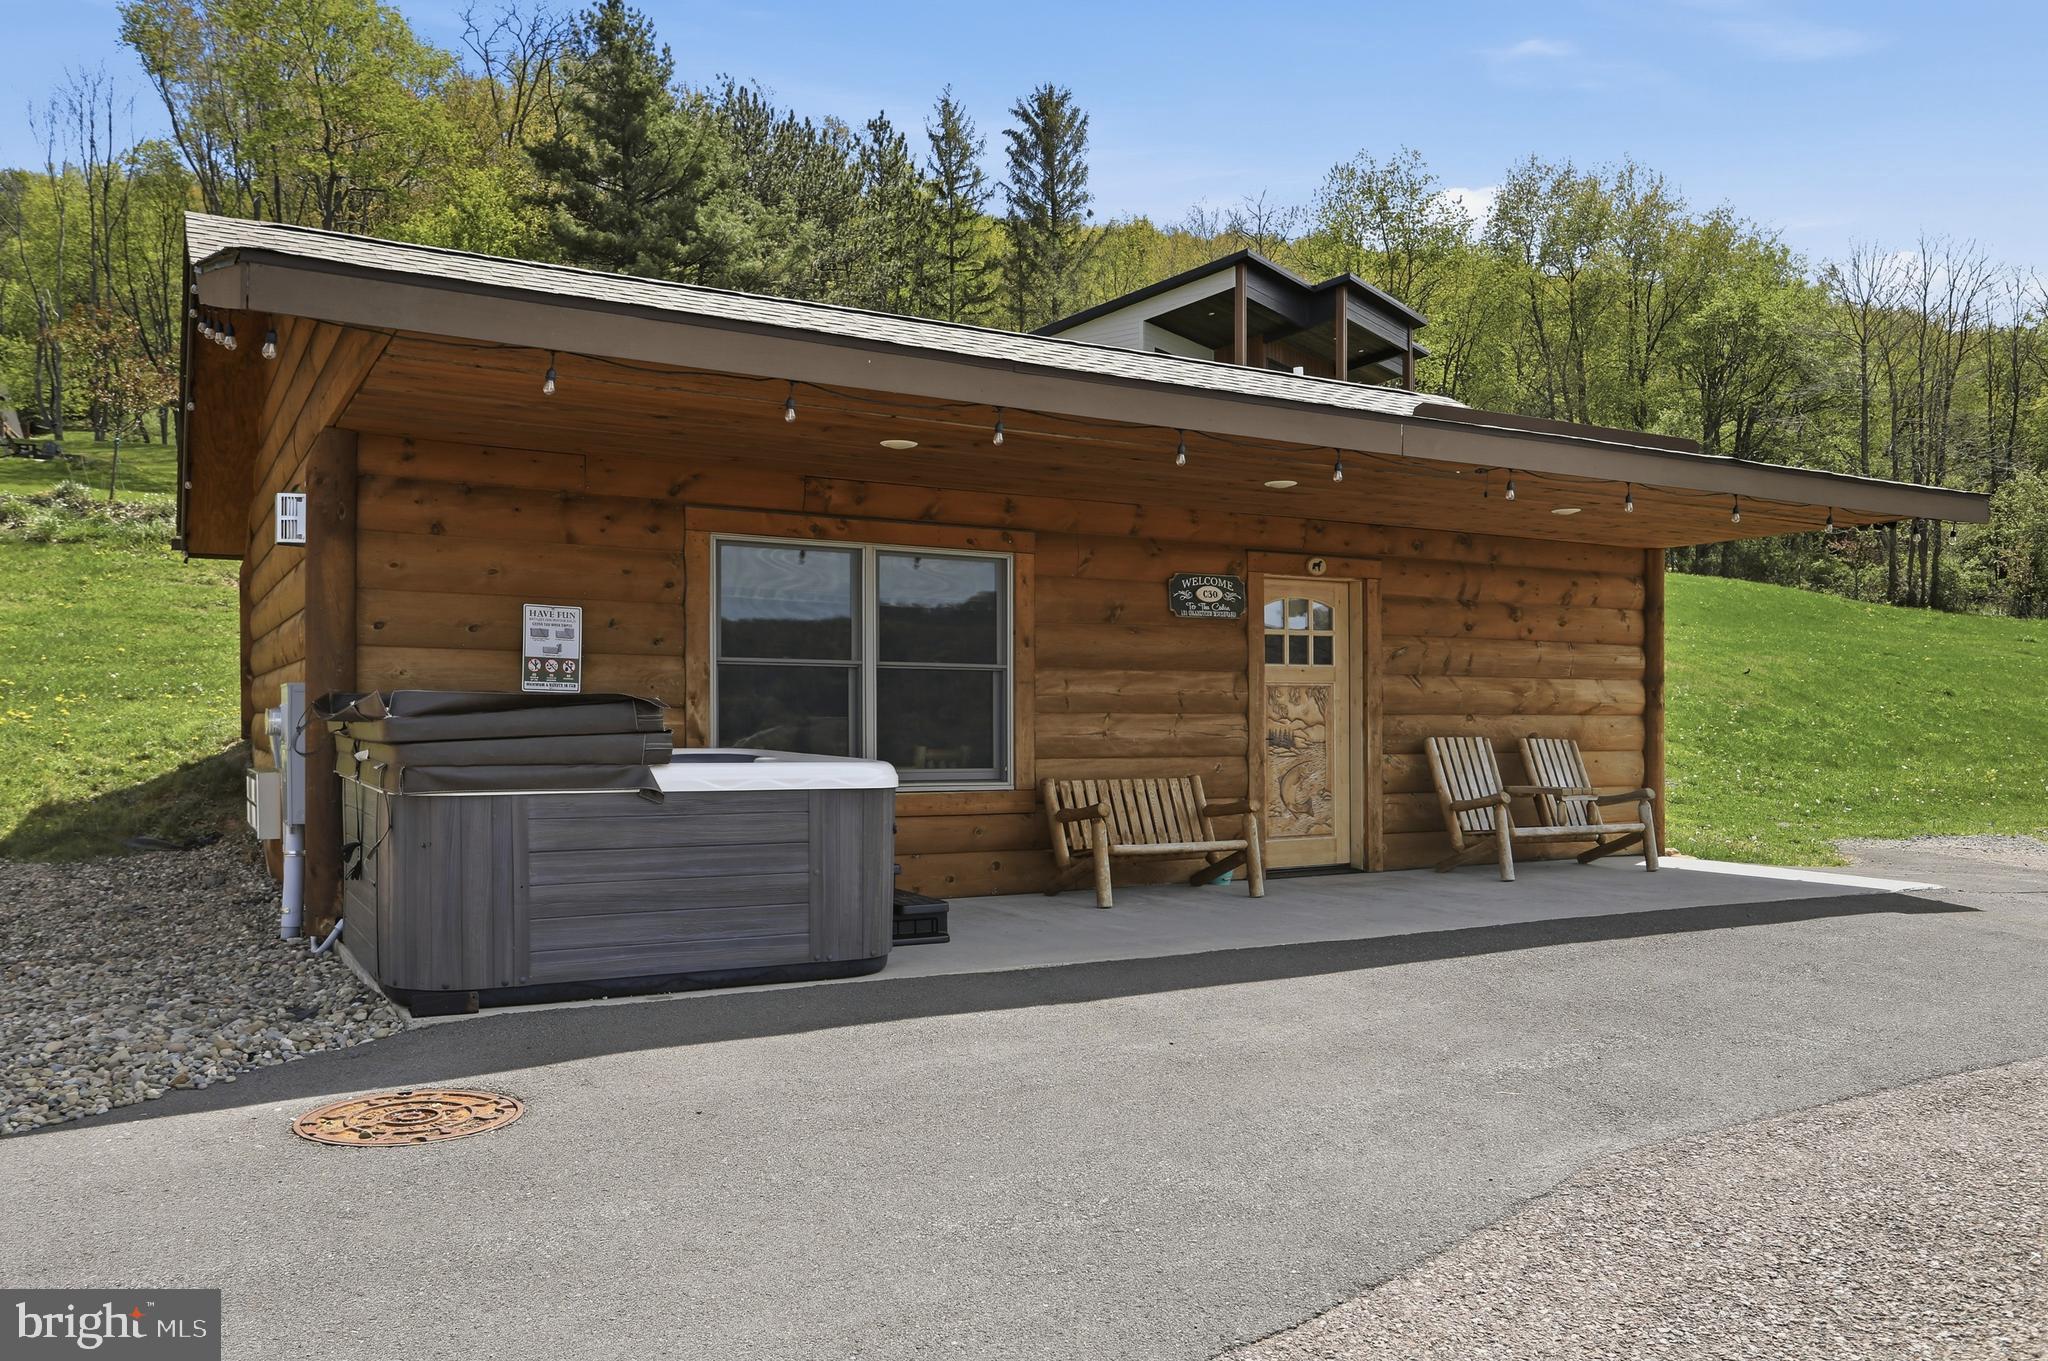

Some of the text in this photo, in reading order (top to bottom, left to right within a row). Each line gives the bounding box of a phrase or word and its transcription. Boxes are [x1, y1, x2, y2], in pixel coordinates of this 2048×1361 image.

[1181, 576, 1234, 591] WELCOME
[1203, 590, 1218, 599] C30
[1185, 601, 1197, 610] To
[529, 609, 576, 619] HAVE FUN
